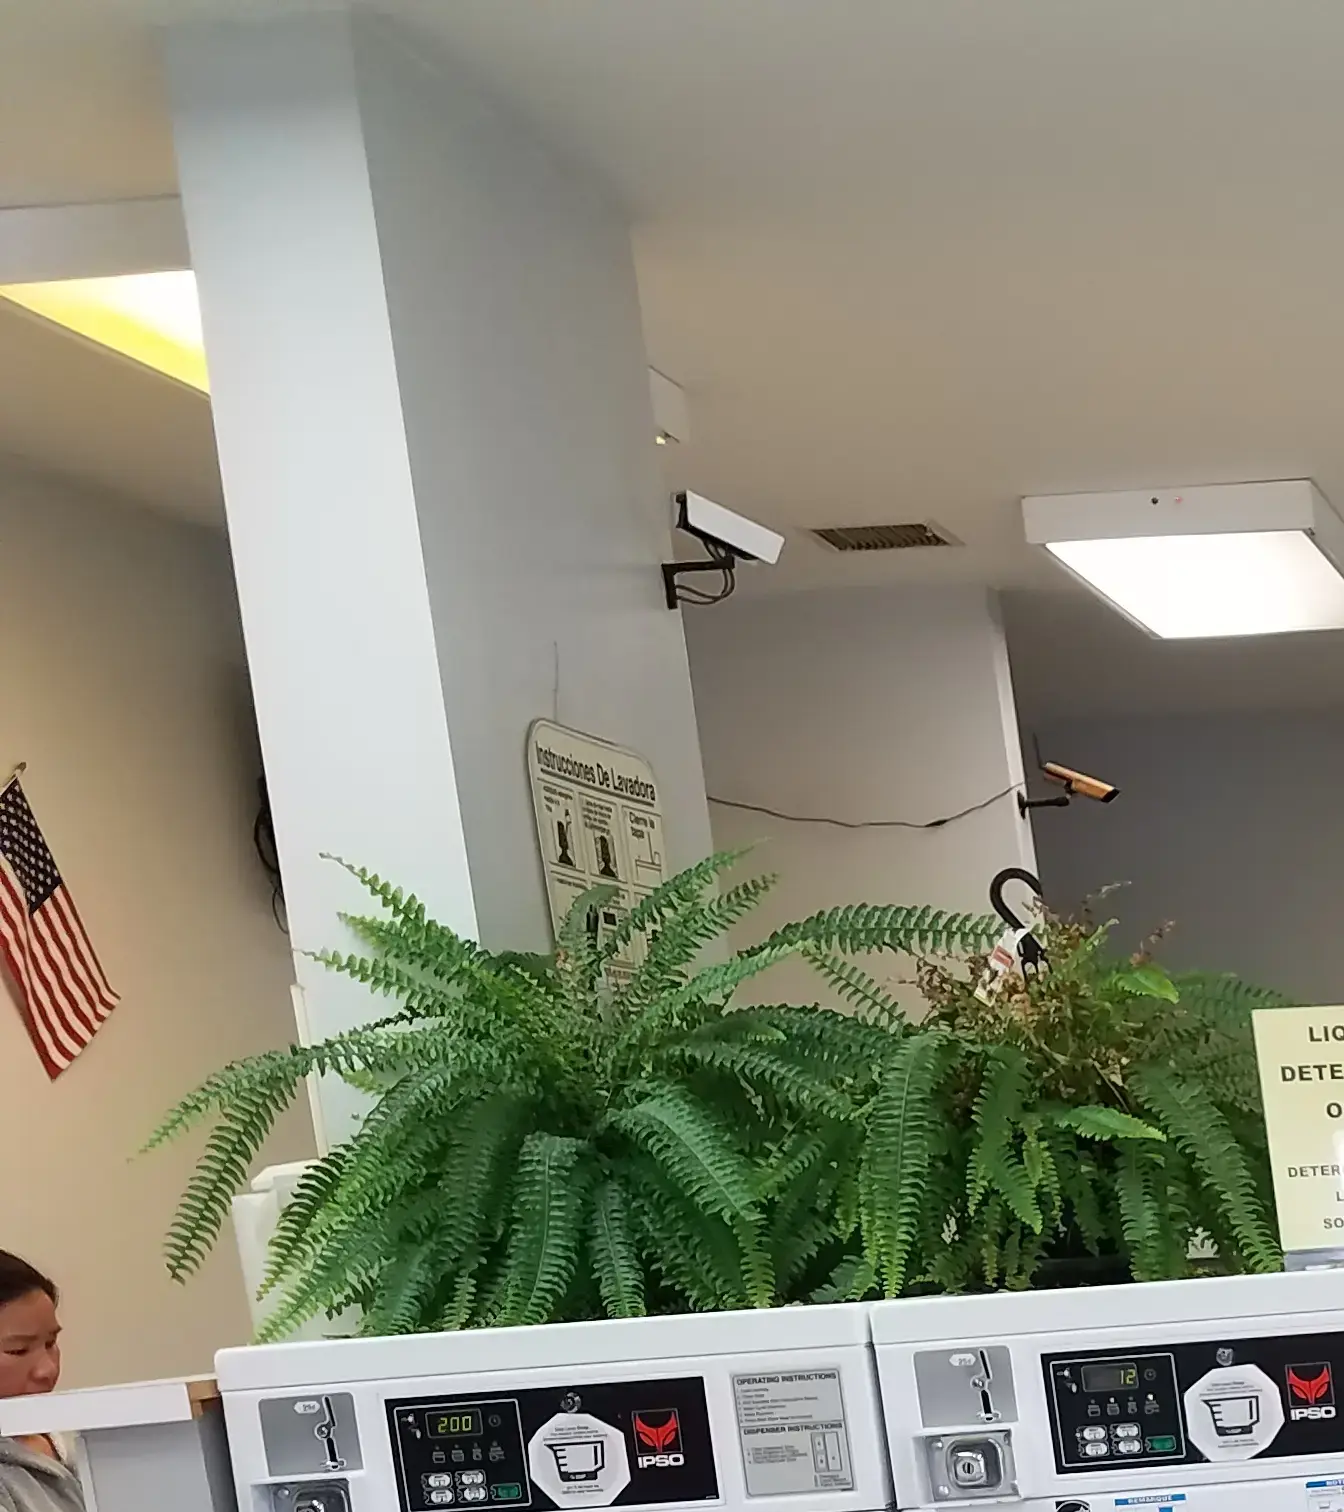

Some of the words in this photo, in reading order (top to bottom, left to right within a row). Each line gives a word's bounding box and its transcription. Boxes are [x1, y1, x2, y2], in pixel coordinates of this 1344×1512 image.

[535, 740, 596, 784] Instrucciones
[596, 763, 611, 788] De
[610, 767, 656, 801] Lavadora
[737, 1376, 780, 1386] OPERATING
[781, 1372, 837, 1383] INSTRUCTIONS
[1119, 1368, 1137, 1385] 12
[1290, 1406, 1337, 1420] IPSO
[437, 1415, 472, 1433] 200
[637, 1452, 685, 1469] IPSO
